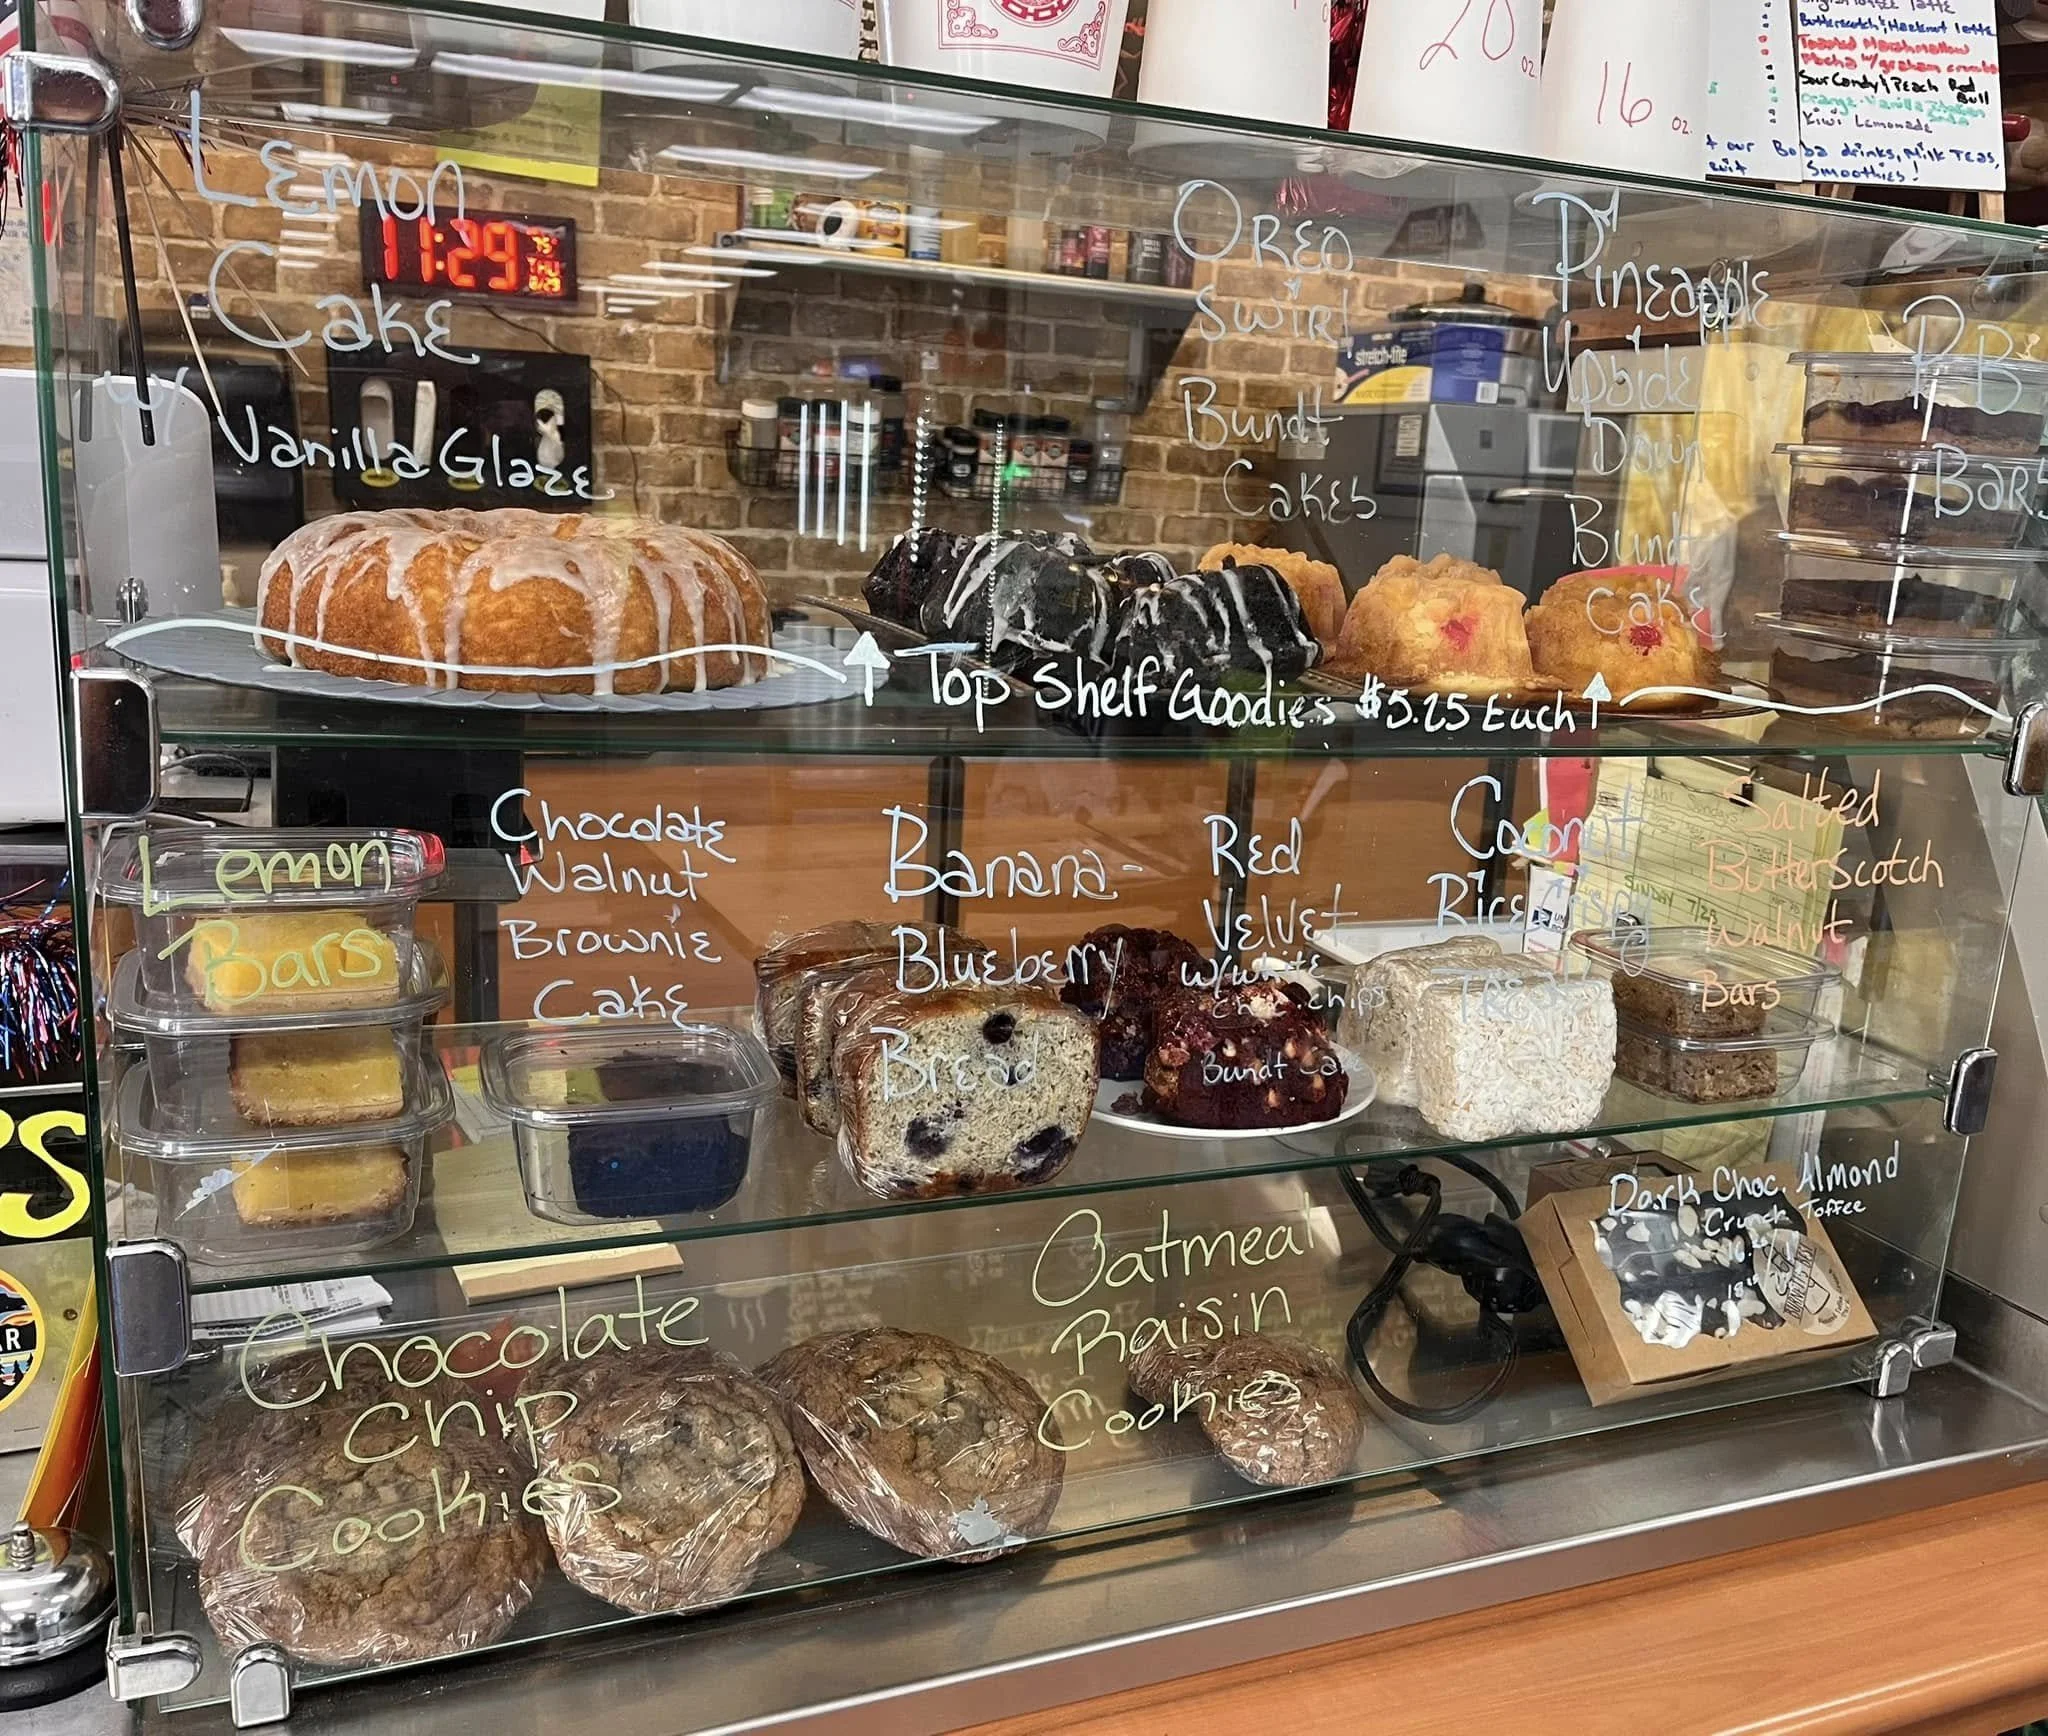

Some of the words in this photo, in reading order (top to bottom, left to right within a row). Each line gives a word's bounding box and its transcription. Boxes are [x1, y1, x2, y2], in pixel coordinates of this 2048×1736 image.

[1420, 0, 1515, 70] 20
[1597, 61, 1652, 127] 16
[1803, 107, 1842, 126] Kiwi
[1856, 115, 1933, 133] Lemonade
[1957, 91, 1989, 105] Bull
[190, 90, 474, 250] Lemon
[1727, 142, 1755, 152] our
[382, 218, 521, 292] 11:29
[208, 240, 481, 364] Cake
[1902, 295, 2023, 416] PB
[1179, 377, 1344, 450] Bundt
[218, 405, 432, 478] Vanilla
[438, 427, 615, 500] Glaze
[1222, 459, 1378, 523] Cakes
[895, 641, 1012, 732] Top
[1033, 654, 1160, 724] Shelf
[1169, 672, 1337, 729] Goodies
[1358, 672, 1473, 732] $5.25
[1481, 686, 1579, 733] Each
[491, 788, 738, 862] Chocolate
[1724, 766, 1881, 833] Salted
[139, 835, 393, 918] Lemon
[502, 838, 708, 900] Walnut
[1203, 815, 1303, 878] Red
[501, 905, 723, 963] Brownie
[1203, 883, 1359, 952] Velvet
[159, 920, 384, 1003] Bars
[893, 925, 1127, 1019] Blueberry
[1699, 972, 1782, 1014] Bars
[533, 976, 718, 1033] Cake
[871, 1025, 1041, 1101] Bread
[1203, 1048, 1288, 1085] Bundt
[1608, 1173, 1701, 1217] Dark
[1712, 1166, 1787, 1202] Choc.
[1797, 1140, 1900, 1194] Almond
[1797, 1198, 1867, 1220] Toffee
[1032, 1191, 1315, 1307] Oatmeal
[239, 1273, 710, 1411] Chocolate
[1051, 1286, 1292, 1376] Raisin
[239, 1462, 622, 1574] Cookies
